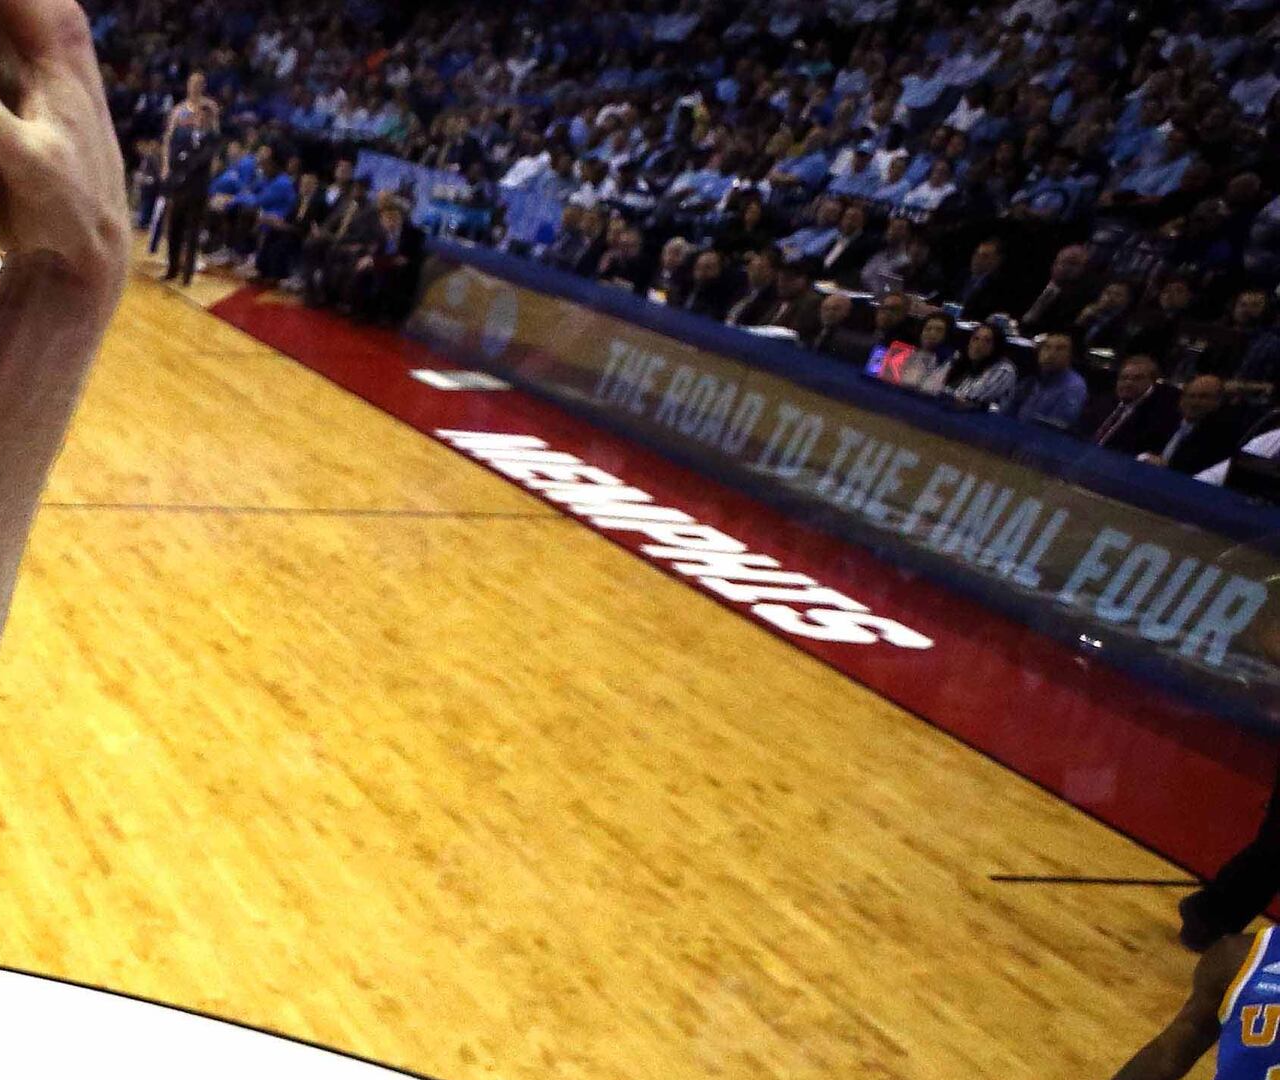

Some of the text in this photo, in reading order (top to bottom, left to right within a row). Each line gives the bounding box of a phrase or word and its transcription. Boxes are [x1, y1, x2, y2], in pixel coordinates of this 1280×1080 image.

[434, 428, 935, 650] MEMPHIS
[596, 337, 1269, 667] THE ROAD TO THE FINAL FOUR
